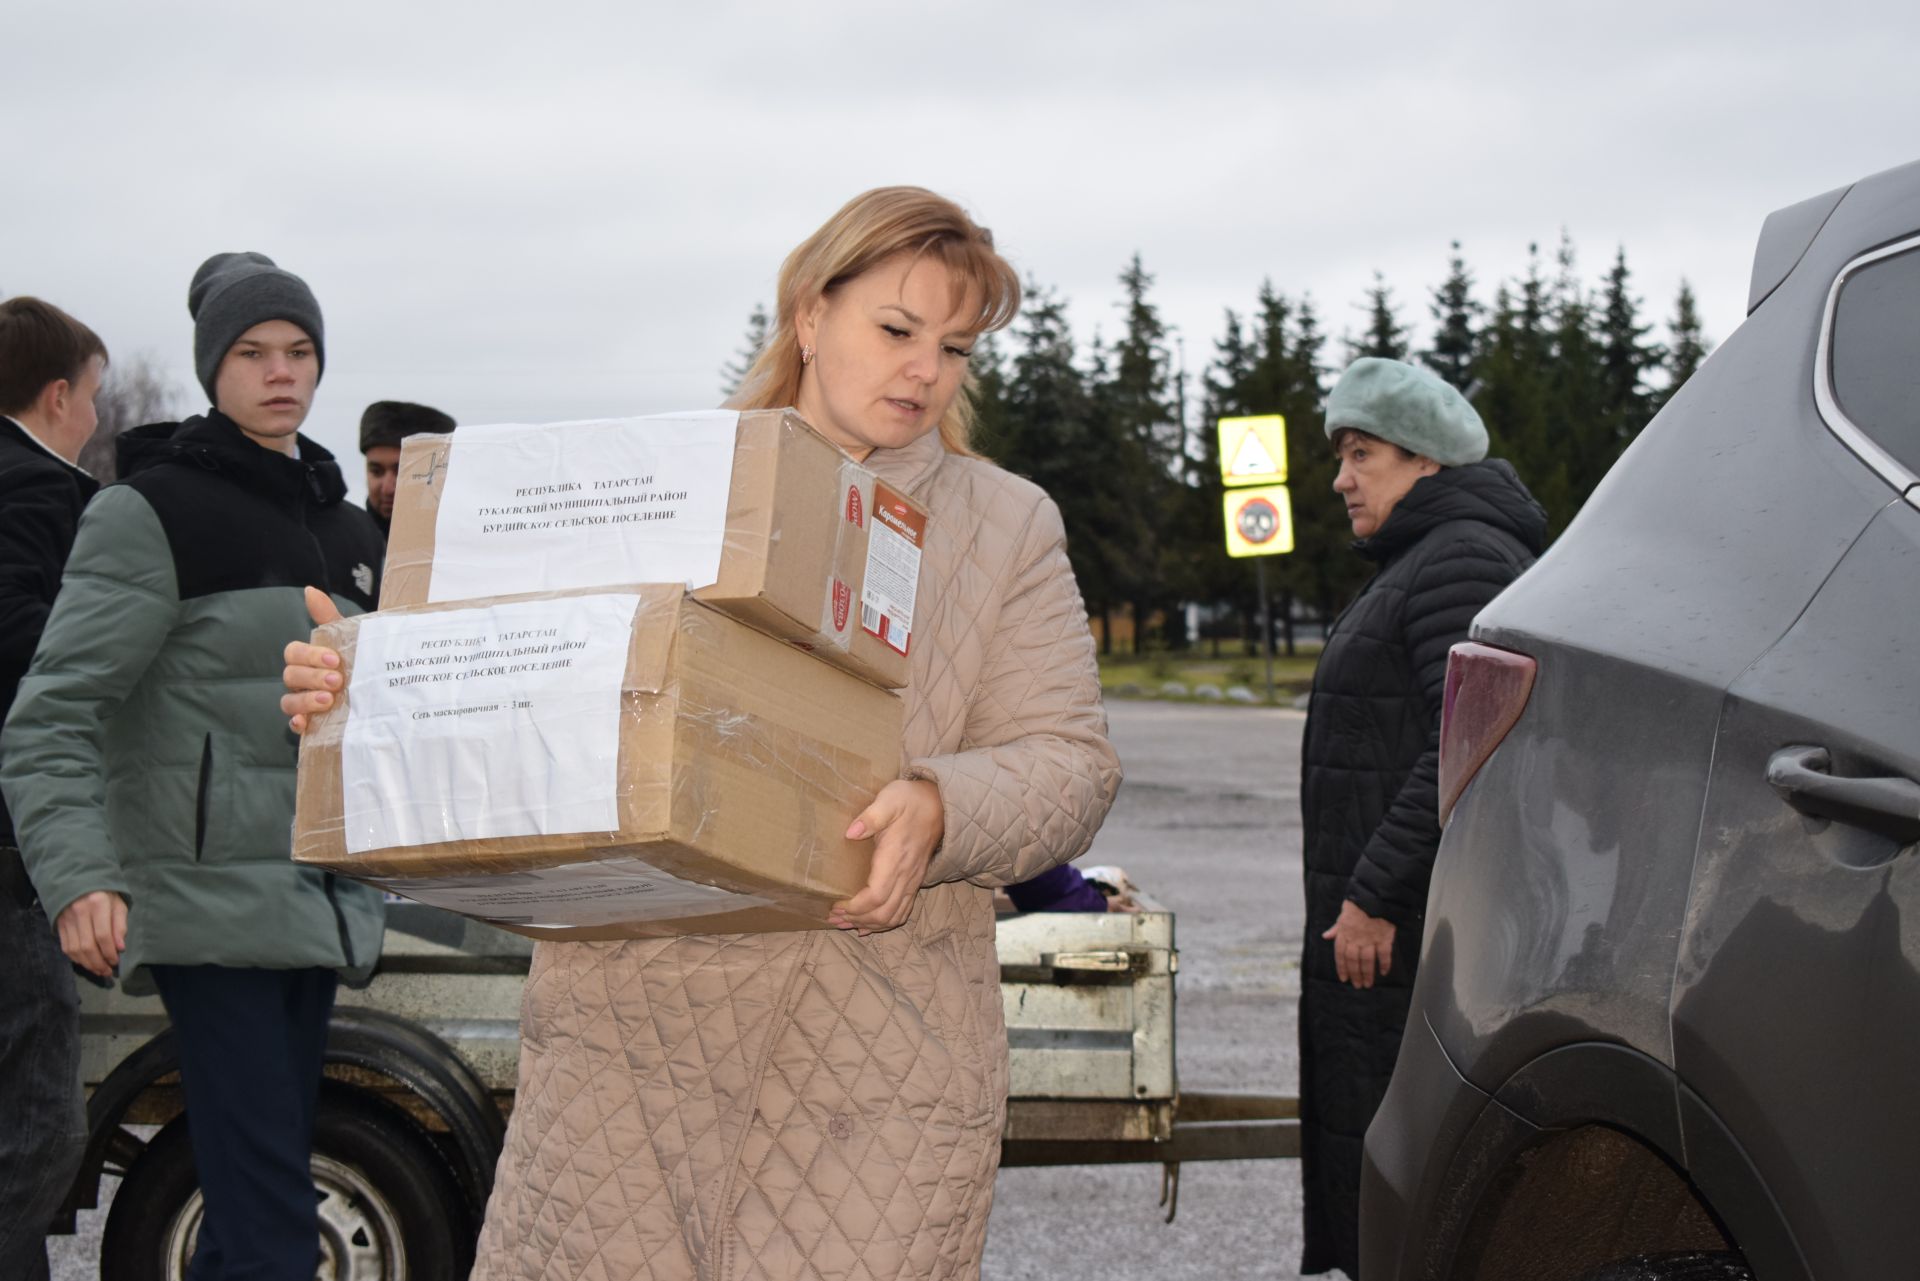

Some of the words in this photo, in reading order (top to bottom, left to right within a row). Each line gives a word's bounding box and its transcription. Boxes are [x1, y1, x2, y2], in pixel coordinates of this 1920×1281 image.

[516, 483, 582, 497] РЕСПУБЛИКА
[593, 476, 653, 490] ТАТАРСТАН
[478, 503, 547, 516] ТУКАЕВСКИЙ
[549, 495, 647, 511] МУНИЦИПАЛЬНЫЙ
[650, 490, 688, 502] РАЙОН
[555, 515, 609, 529] СЕЛЬСКОЕ
[611, 510, 677, 524] ПОСЕЛЕНИЕ
[421, 636, 487, 649] РЕСПУБЛИКА
[498, 629, 557, 643] ТАТАРСТАН
[385, 655, 450, 671] ТУКАЕВСКИЙ
[454, 644, 548, 663] МУНИЦИПАЛЬНЫЙ
[551, 641, 586, 653] РАЙОН
[389, 673, 453, 687] БУРДИНСКОЕ
[455, 665, 507, 680] СЕЛЬСКОЕ
[509, 659, 573, 673] ПОСЕЛЕНИЕ
[412, 710, 431, 721] Сеть
[433, 703, 499, 718] маскировочная
[511, 699, 516, 710] 3
[518, 699, 534, 709] шт.
